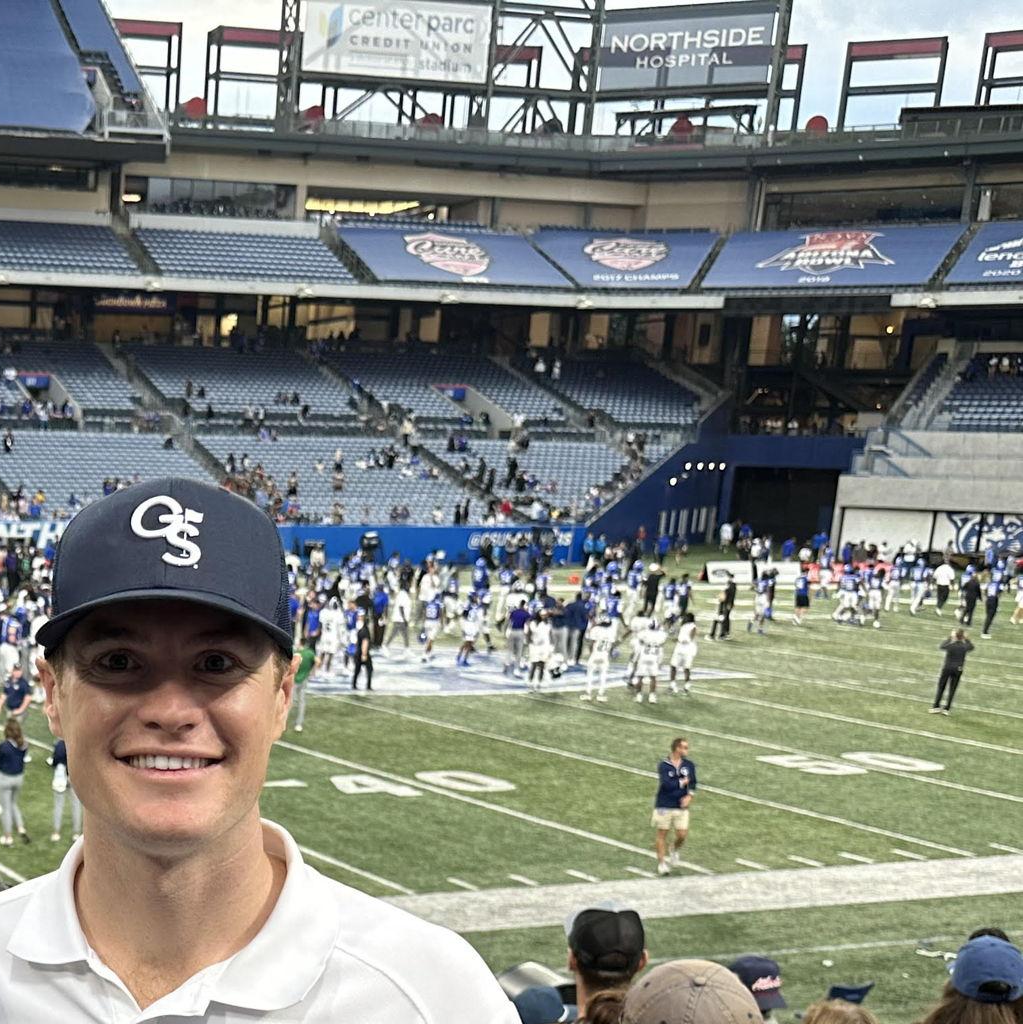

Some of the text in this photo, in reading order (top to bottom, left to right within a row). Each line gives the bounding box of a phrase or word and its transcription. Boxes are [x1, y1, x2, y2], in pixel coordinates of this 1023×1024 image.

[350, 35, 473, 54] CREDIT UNION
[611, 26, 765, 53] NORTHSIDE
[635, 52, 733, 70] HOSPITAL
